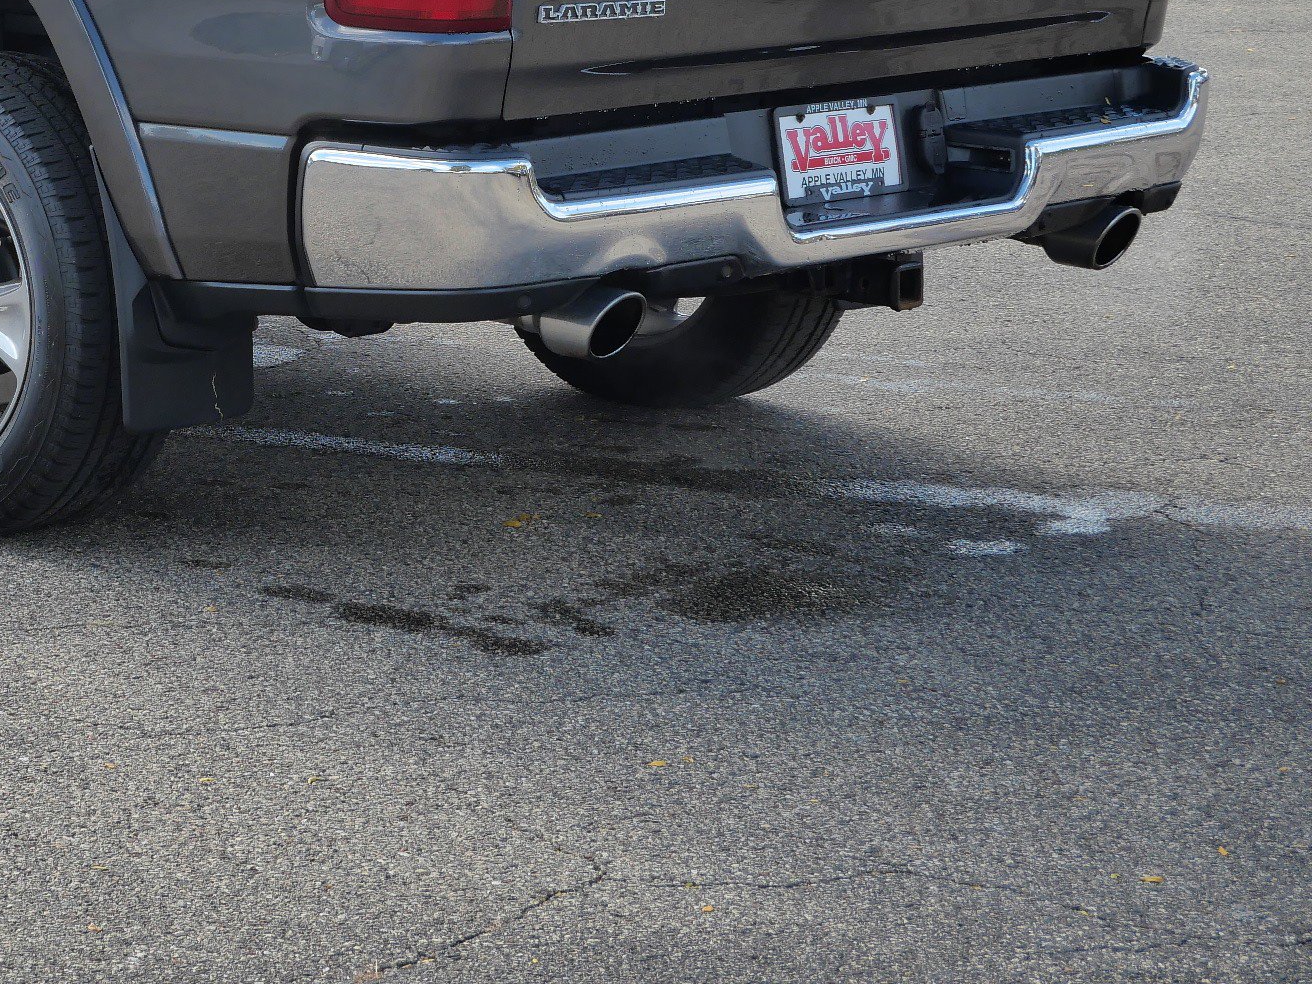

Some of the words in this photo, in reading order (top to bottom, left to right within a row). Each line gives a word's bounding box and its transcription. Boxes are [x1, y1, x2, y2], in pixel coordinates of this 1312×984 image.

[806, 102, 828, 114] APPLE
[857, 98, 868, 108] MN
[785, 114, 888, 173] Valley
[824, 156, 842, 166] BUICK
[844, 154, 858, 164] GMC
[801, 172, 831, 188] APPLE
[871, 167, 885, 179] MN
[820, 181, 874, 200] Valley
